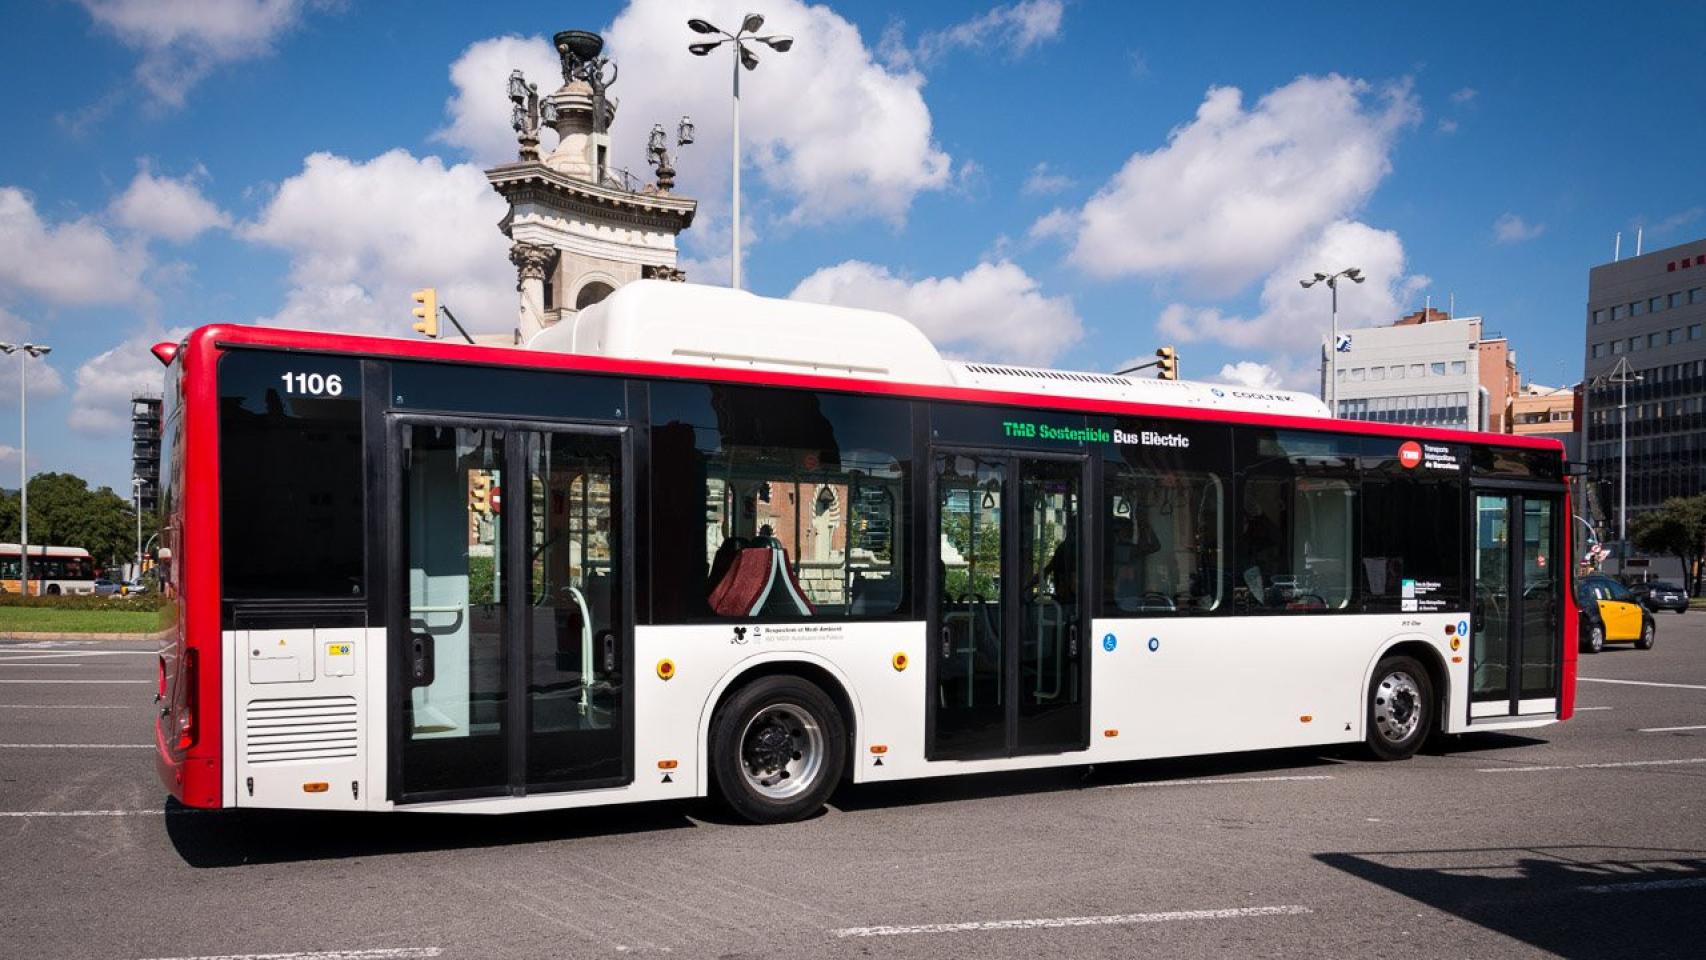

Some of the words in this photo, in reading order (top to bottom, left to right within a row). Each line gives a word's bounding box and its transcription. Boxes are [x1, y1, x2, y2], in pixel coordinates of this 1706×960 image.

[281, 371, 343, 396] 1106
[1003, 422, 1036, 438] TMB
[1039, 424, 1110, 443] Sostenible
[1113, 429, 1139, 444] Bus
[1141, 431, 1190, 448] Elèctric
